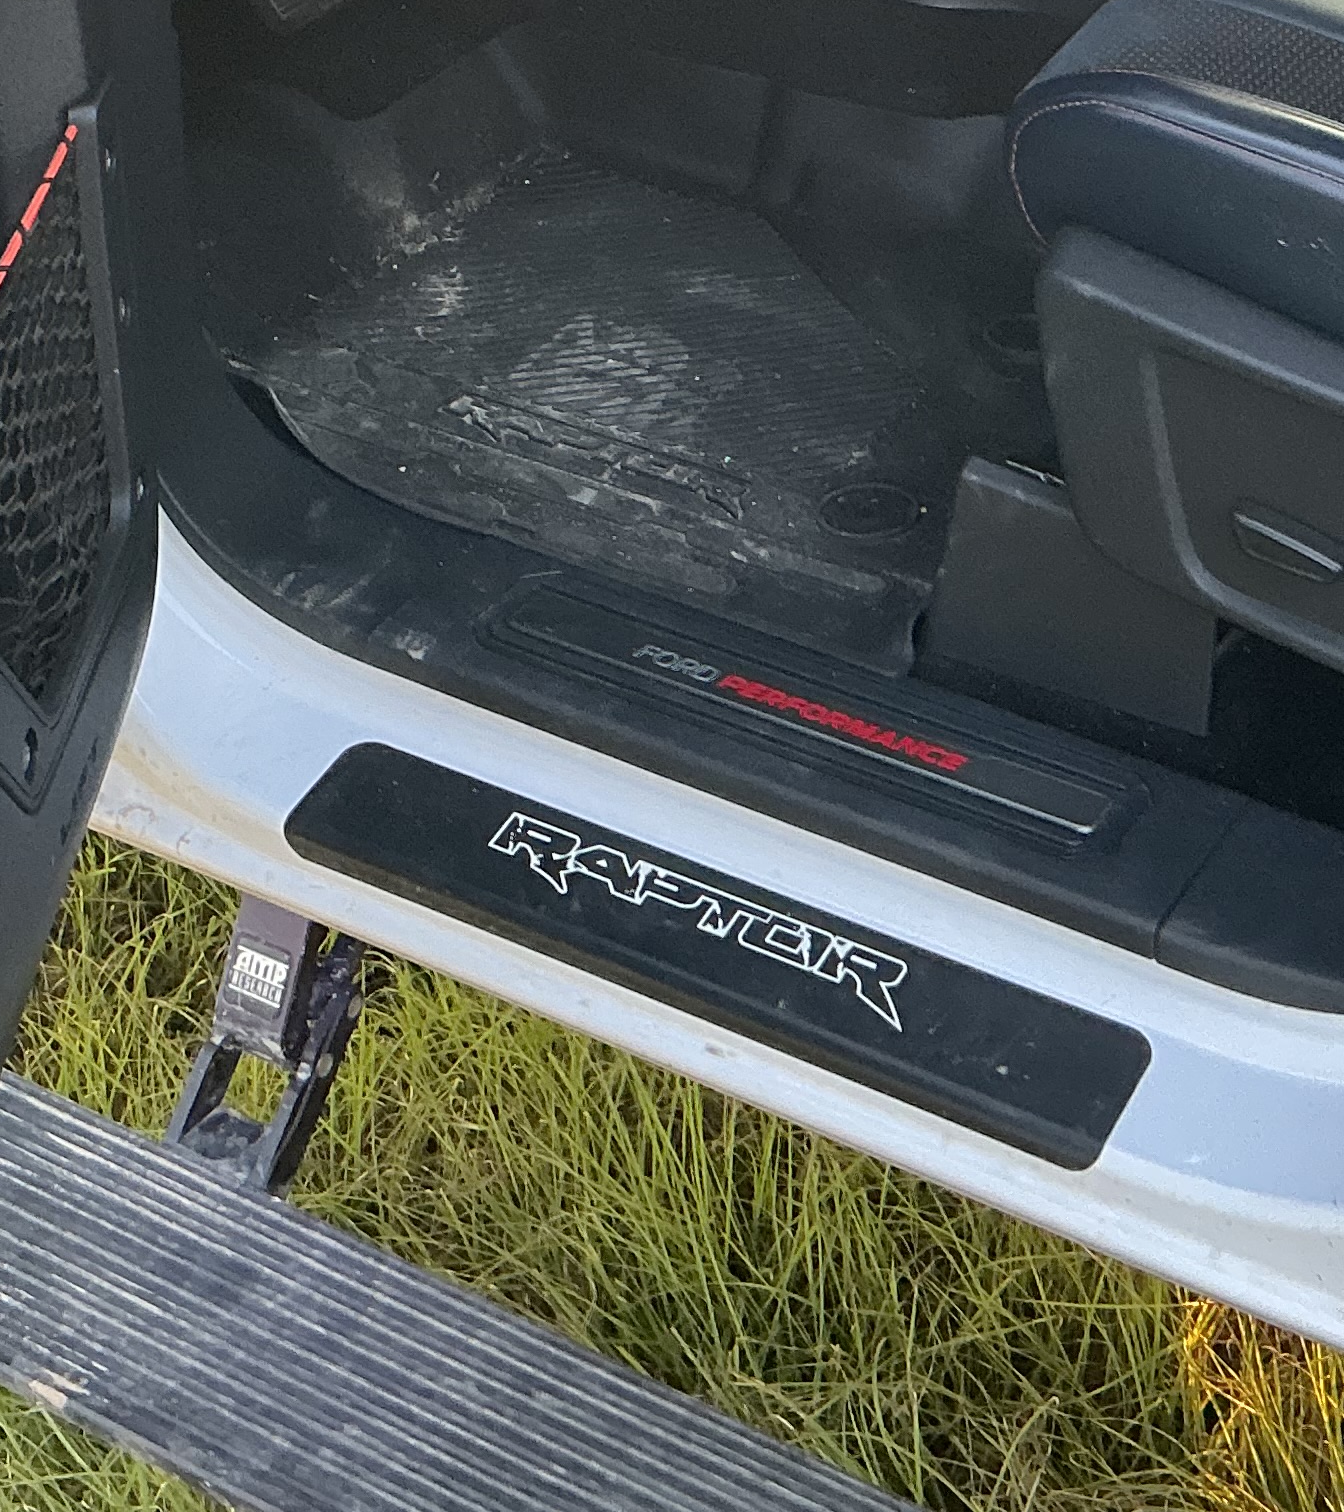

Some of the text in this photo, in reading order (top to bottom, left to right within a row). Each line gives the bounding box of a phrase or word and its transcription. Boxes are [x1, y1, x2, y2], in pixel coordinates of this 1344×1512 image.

[632, 644, 970, 772] FORD PERFORMANCE
[488, 811, 907, 1032] RAPTOR
[231, 969, 282, 1004] RESEARCH
